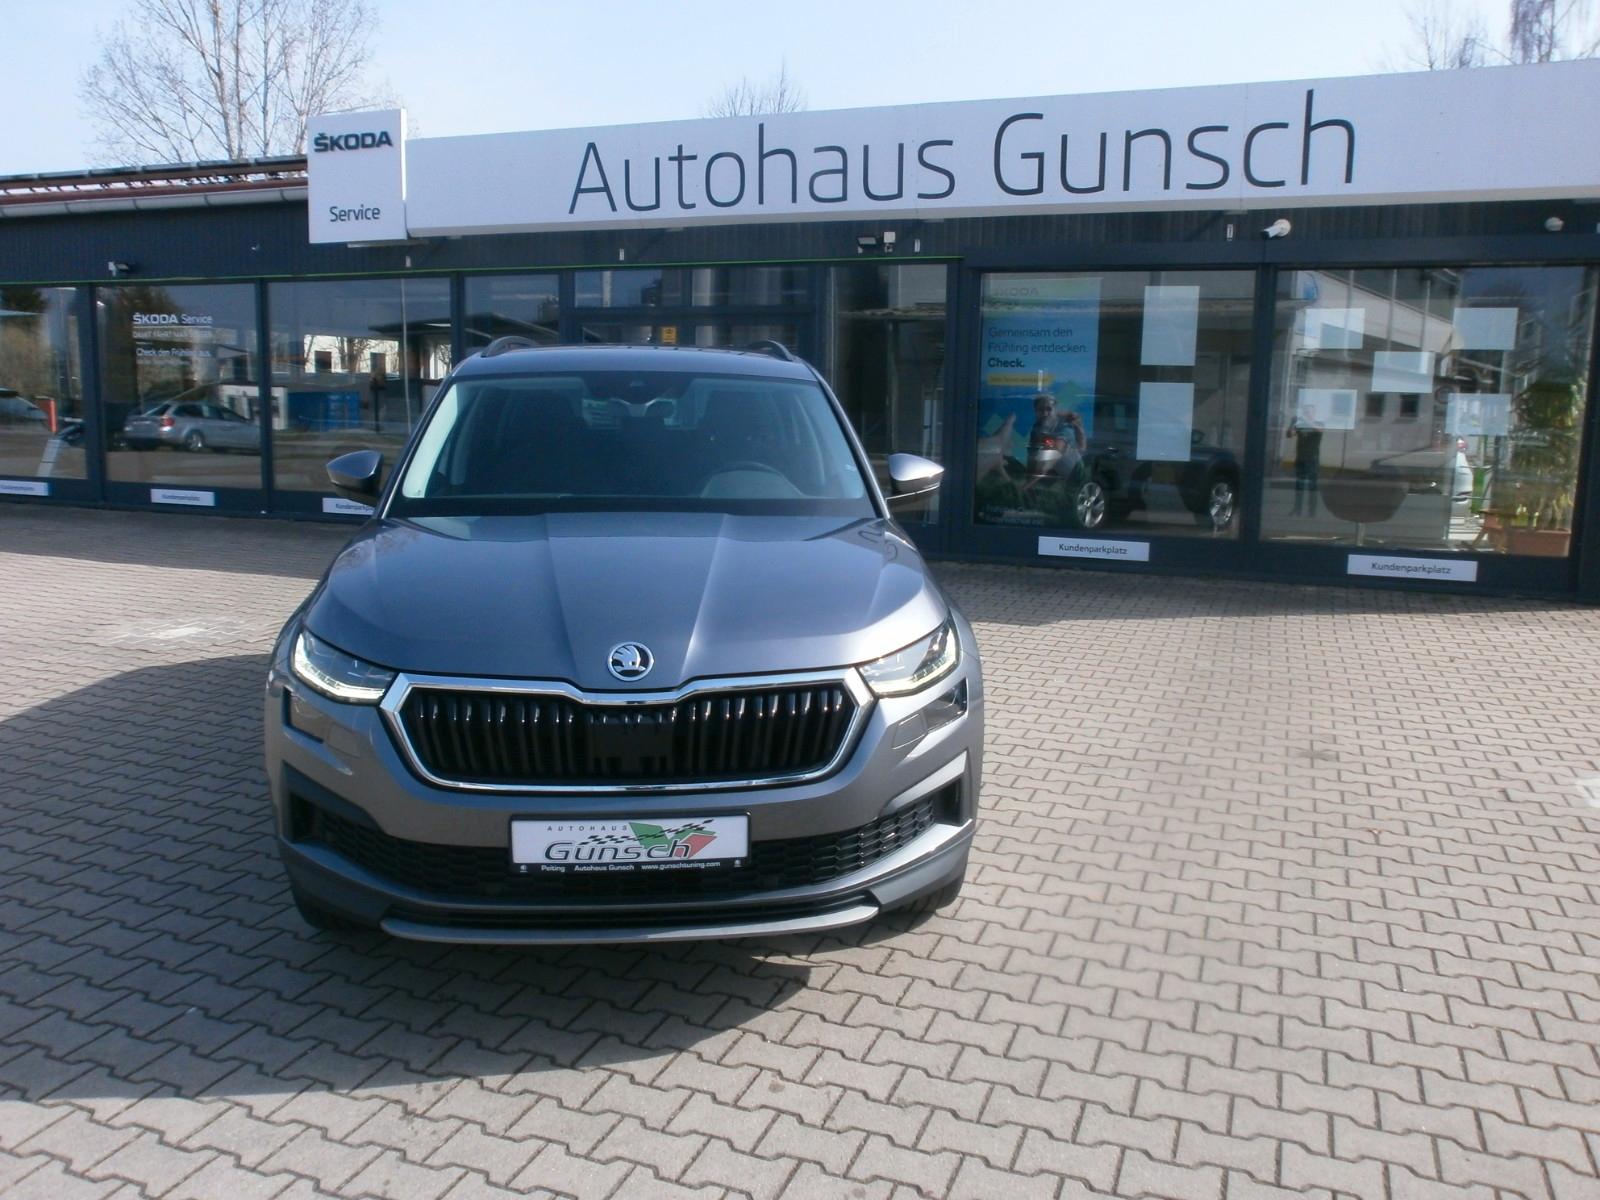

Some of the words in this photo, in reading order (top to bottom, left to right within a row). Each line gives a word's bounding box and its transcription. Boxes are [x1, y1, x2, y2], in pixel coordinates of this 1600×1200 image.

[314, 131, 394, 153] ŠKODA
[566, 122, 956, 215] Autohaus
[993, 89, 1357, 197] Gunsch
[329, 204, 381, 222] Service
[132, 312, 179, 325] ŠKODA
[181, 313, 213, 325] Service
[988, 326, 1051, 338] Gemeinsam
[1053, 327, 1073, 338] den
[987, 341, 1029, 356] Frühling
[987, 357, 1025, 368] Check.
[1059, 543, 1128, 555] Kundenparkplatz
[1371, 562, 1452, 575] Kundenparkplatz
[544, 839, 691, 861] Gunsch
[574, 864, 607, 872] Autohaus
[608, 863, 635, 872] Gunsch
[641, 861, 721, 871] www.gunschtuning.com
